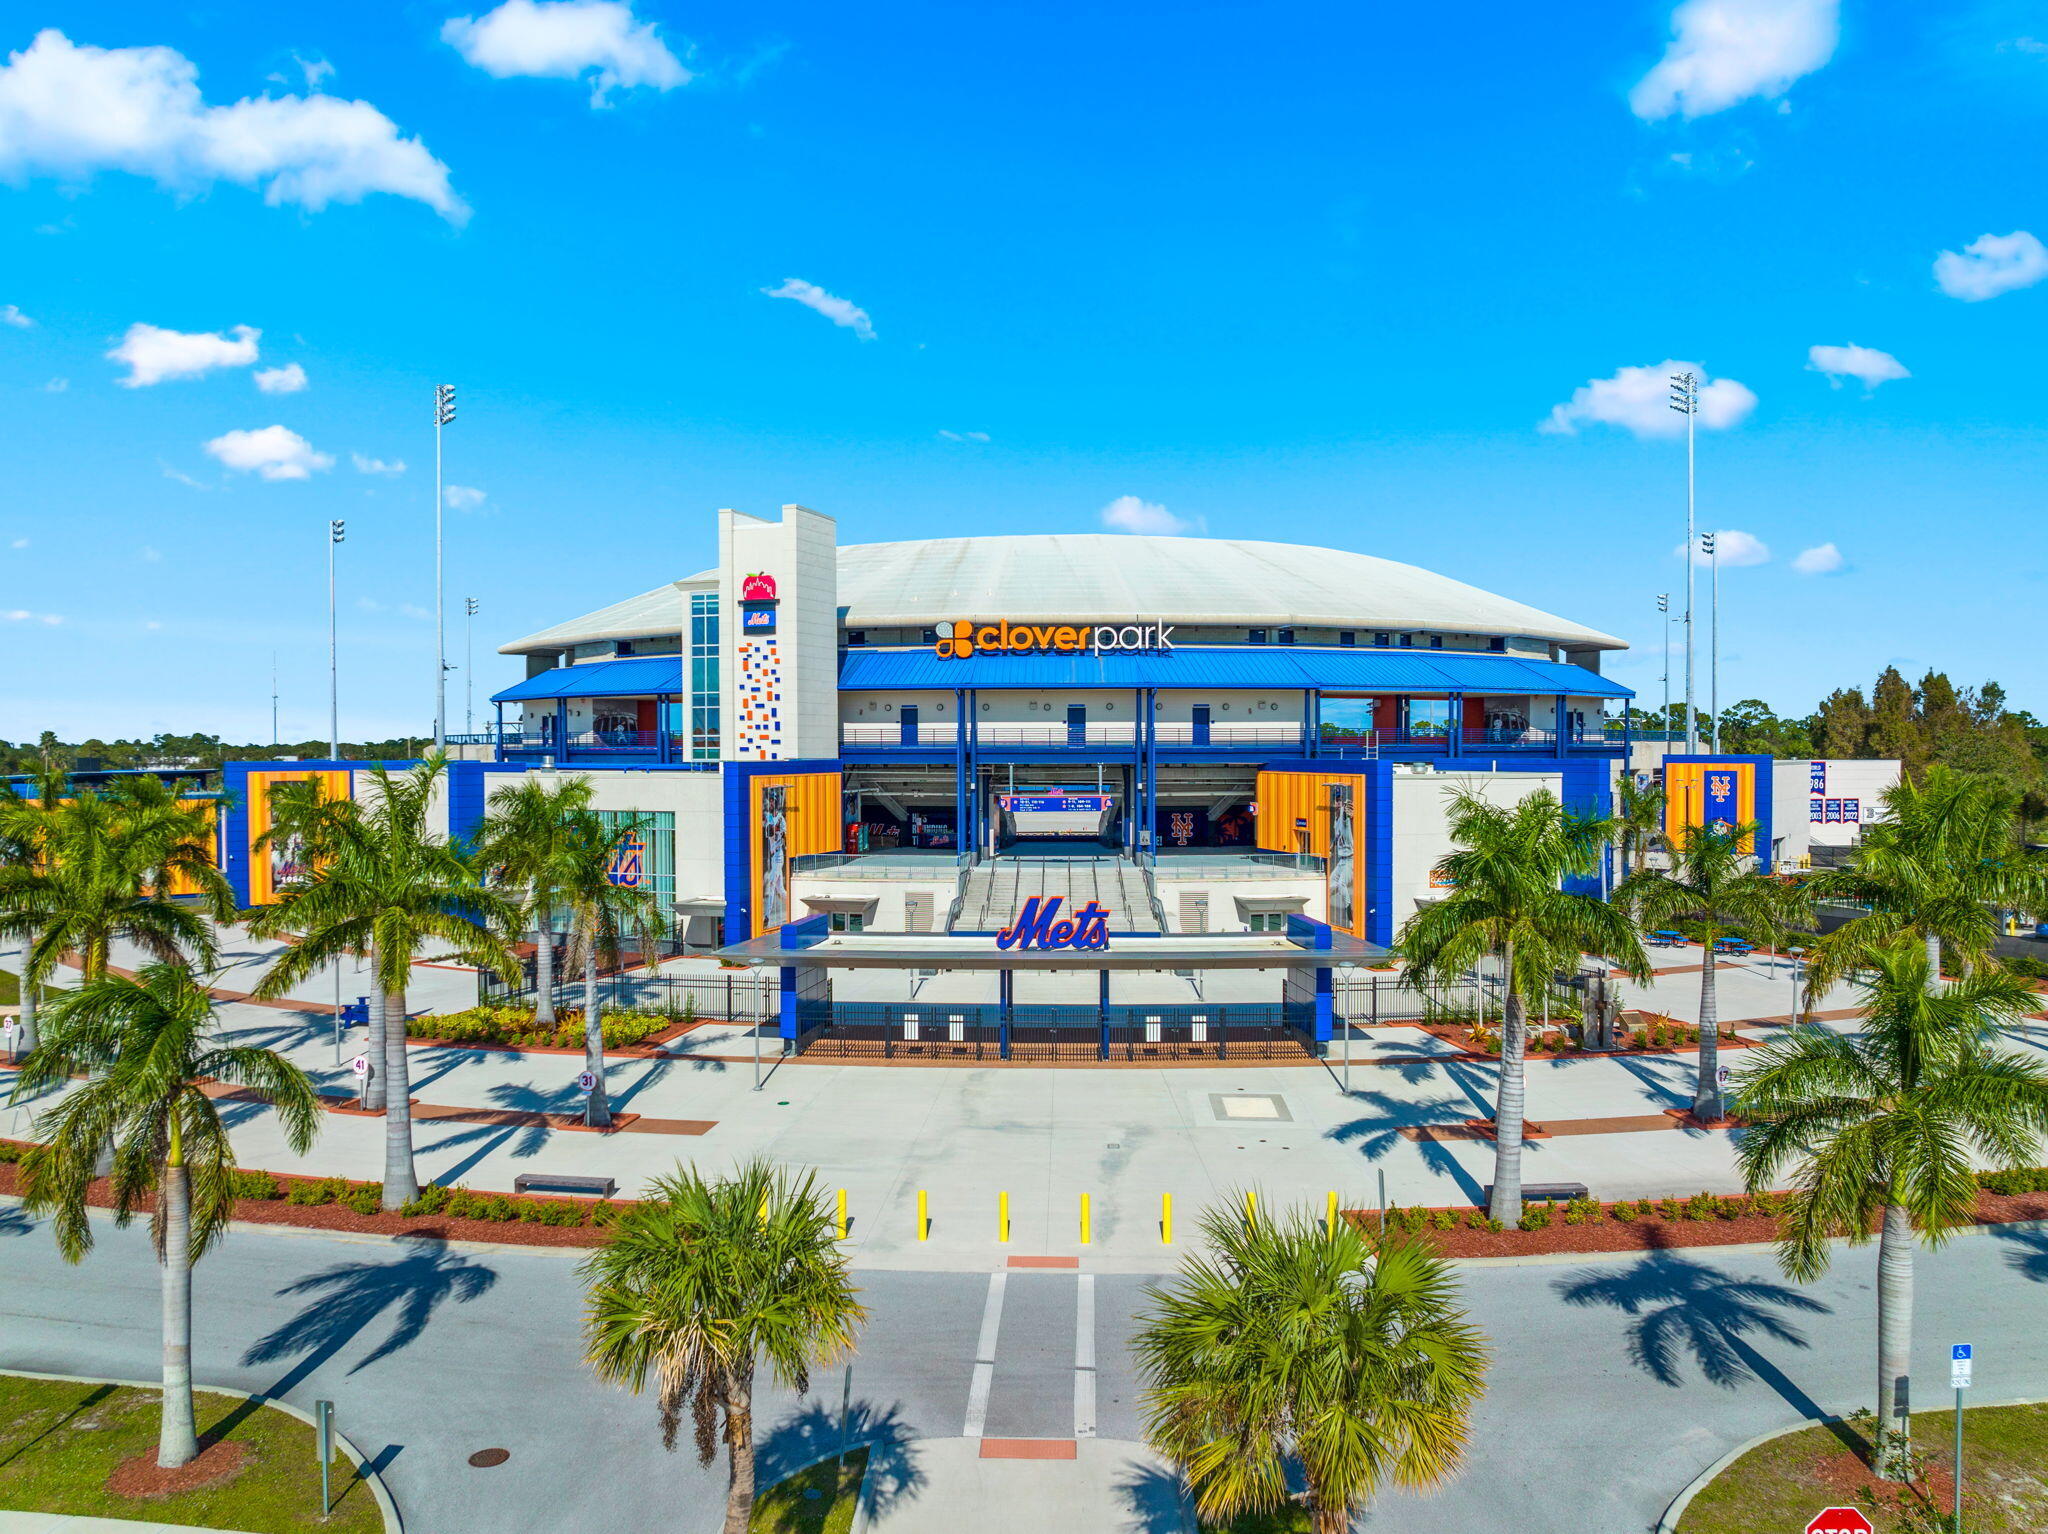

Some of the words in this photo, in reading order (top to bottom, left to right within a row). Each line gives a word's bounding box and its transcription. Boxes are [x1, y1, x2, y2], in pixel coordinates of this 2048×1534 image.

[977, 618, 1090, 651] clover
[1094, 617, 1175, 657] park
[1809, 778, 1824, 789] 986
[1844, 811, 1858, 820] 2022
[996, 896, 1112, 950] Mets
[355, 1060, 365, 1070] 41
[582, 1075, 593, 1087] 31
